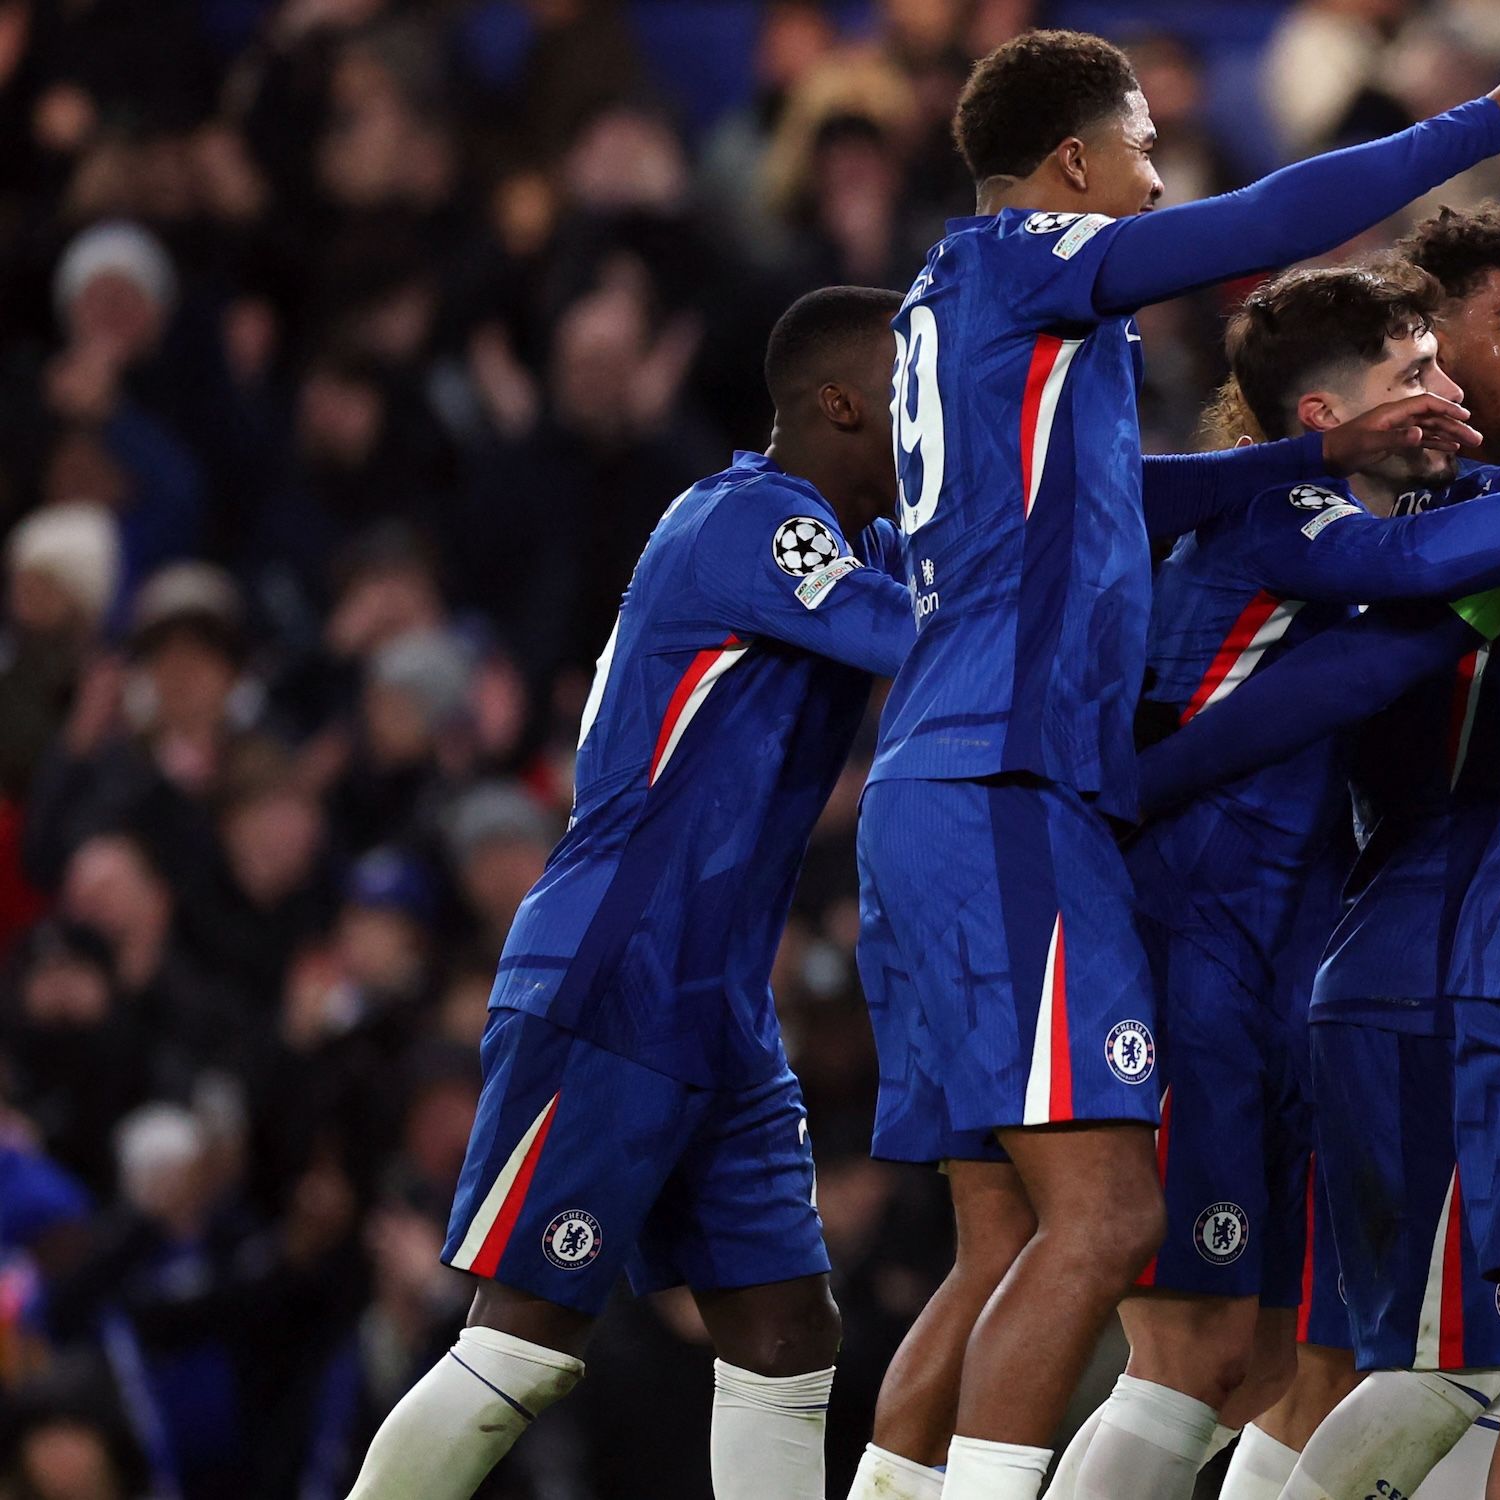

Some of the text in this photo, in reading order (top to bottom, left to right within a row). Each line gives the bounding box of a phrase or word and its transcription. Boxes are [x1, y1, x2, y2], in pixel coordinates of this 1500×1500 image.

[1115, 1022, 1147, 1038] CHELSEA
[1206, 1204, 1242, 1219] CHELSEA
[562, 1211, 597, 1231] CHELSEA
